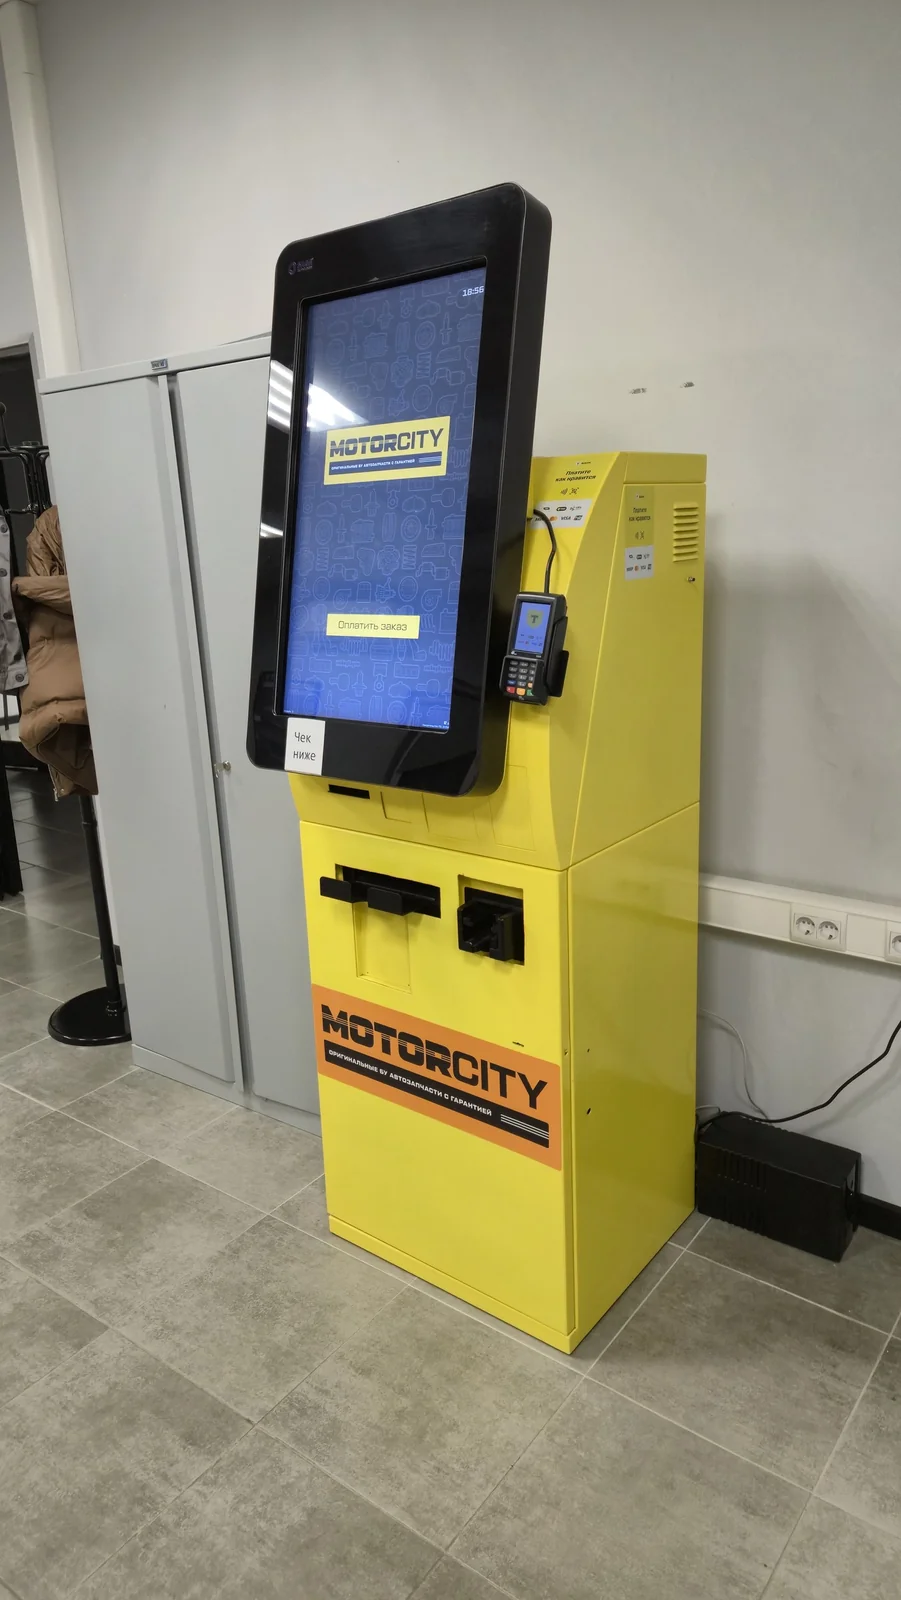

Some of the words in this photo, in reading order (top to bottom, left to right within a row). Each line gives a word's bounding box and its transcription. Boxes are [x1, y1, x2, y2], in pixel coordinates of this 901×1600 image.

[462, 286, 484, 296] 18:56
[329, 428, 444, 457] MOTORCITY
[338, 620, 379, 630] Оплатить
[380, 623, 408, 631] заказ
[294, 731, 312, 744] Чек
[292, 750, 317, 761] ниже
[321, 1004, 548, 1110] MOTORCITY
[328, 1049, 378, 1073] ОРИГИНАЛЬНЫЕ
[379, 1068, 388, 1076] БУ
[389, 1072, 443, 1097] АВТОЗАПЧАСТИ
[443, 1092, 449, 1100] С
[450, 1095, 492, 1116] ГАРАНТИЕЙ
